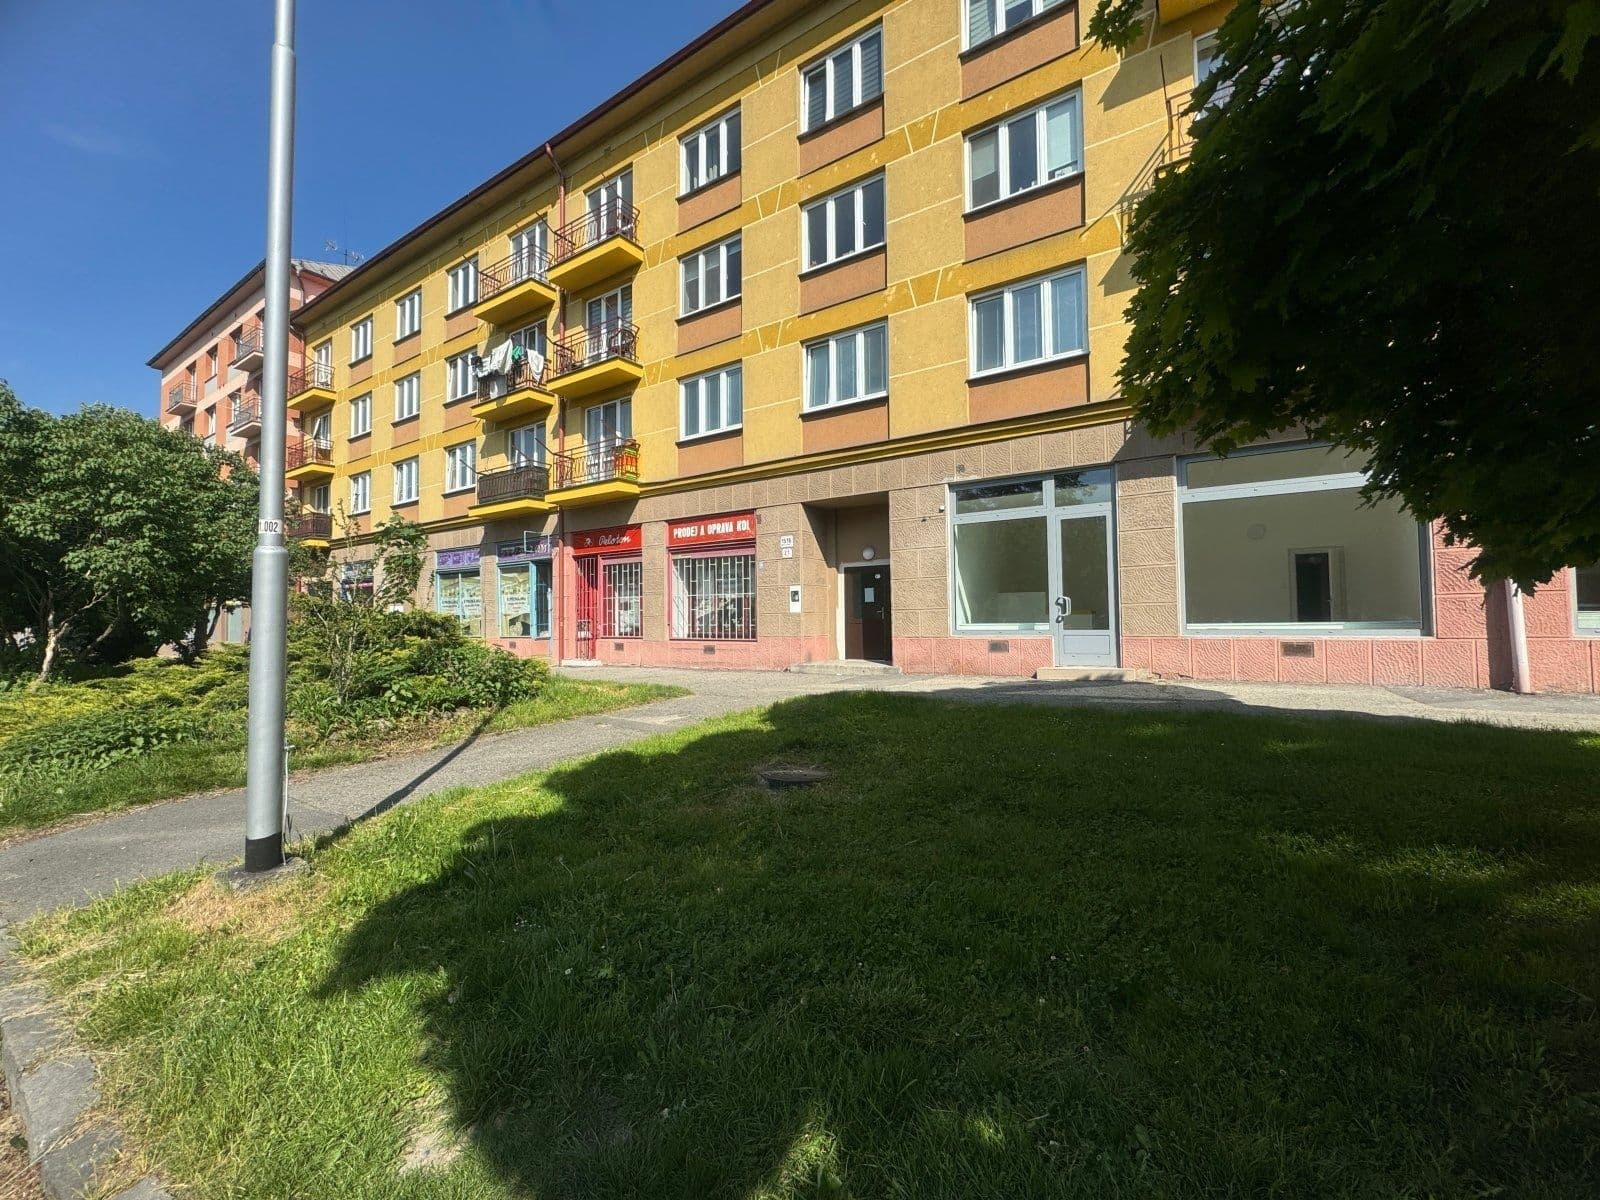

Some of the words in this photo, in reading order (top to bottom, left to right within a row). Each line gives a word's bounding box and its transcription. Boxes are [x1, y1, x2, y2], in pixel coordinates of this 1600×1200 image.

[673, 526, 699, 539] PRODEJ
[700, 525, 705, 537] A
[707, 521, 734, 535] OPRAVA
[736, 520, 751, 532] KOL
